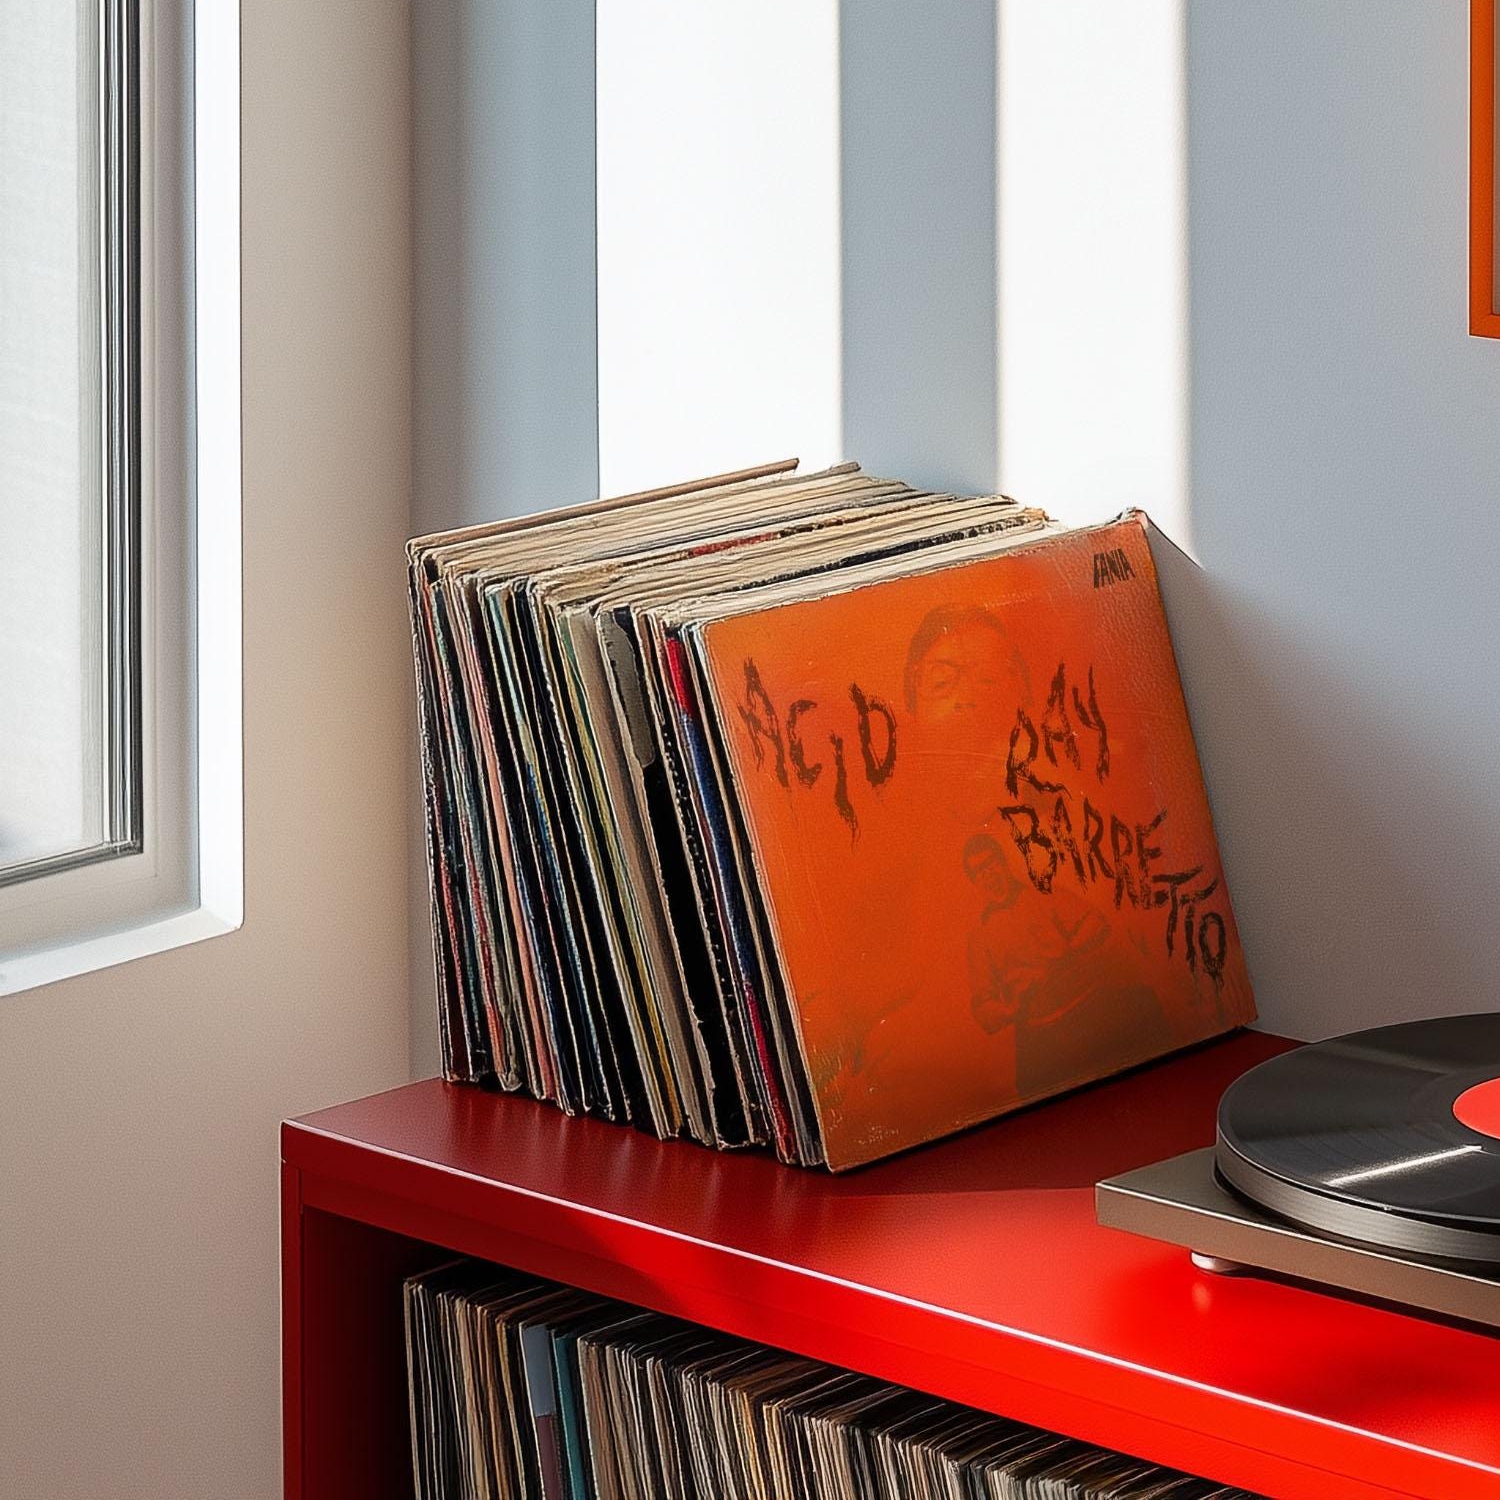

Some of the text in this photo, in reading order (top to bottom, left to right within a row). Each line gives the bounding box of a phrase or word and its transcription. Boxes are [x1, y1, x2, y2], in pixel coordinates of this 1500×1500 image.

[1093, 547, 1136, 589] FANIA
[738, 657, 897, 845] ACID
[1005, 661, 1111, 799] RAY
